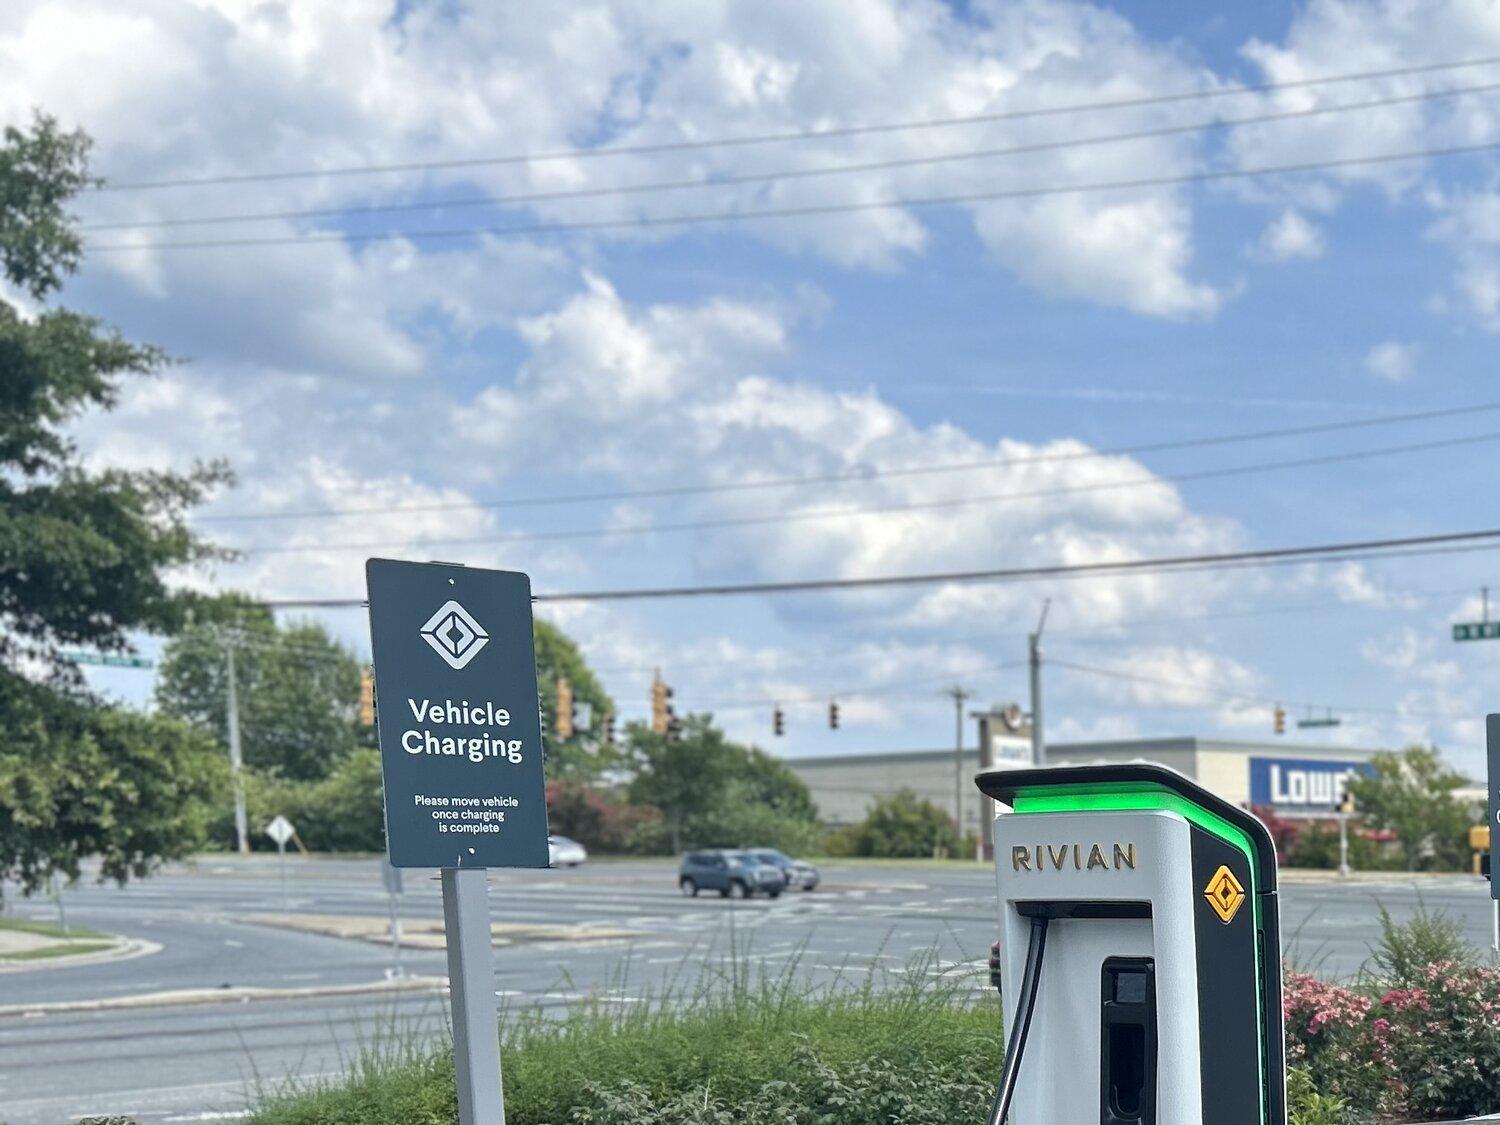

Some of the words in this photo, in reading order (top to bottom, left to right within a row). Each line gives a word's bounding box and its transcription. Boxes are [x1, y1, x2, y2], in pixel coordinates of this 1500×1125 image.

[408, 698, 511, 727] Vehicle
[401, 730, 523, 764] Charging
[414, 795, 449, 807] Please
[452, 797, 479, 807] move
[482, 796, 519, 808] vehicle
[432, 810, 459, 820] once
[461, 809, 505, 822] charging
[439, 822, 448, 833] is
[450, 823, 500, 835] complete
[1012, 843, 1137, 872] RIVIAN
